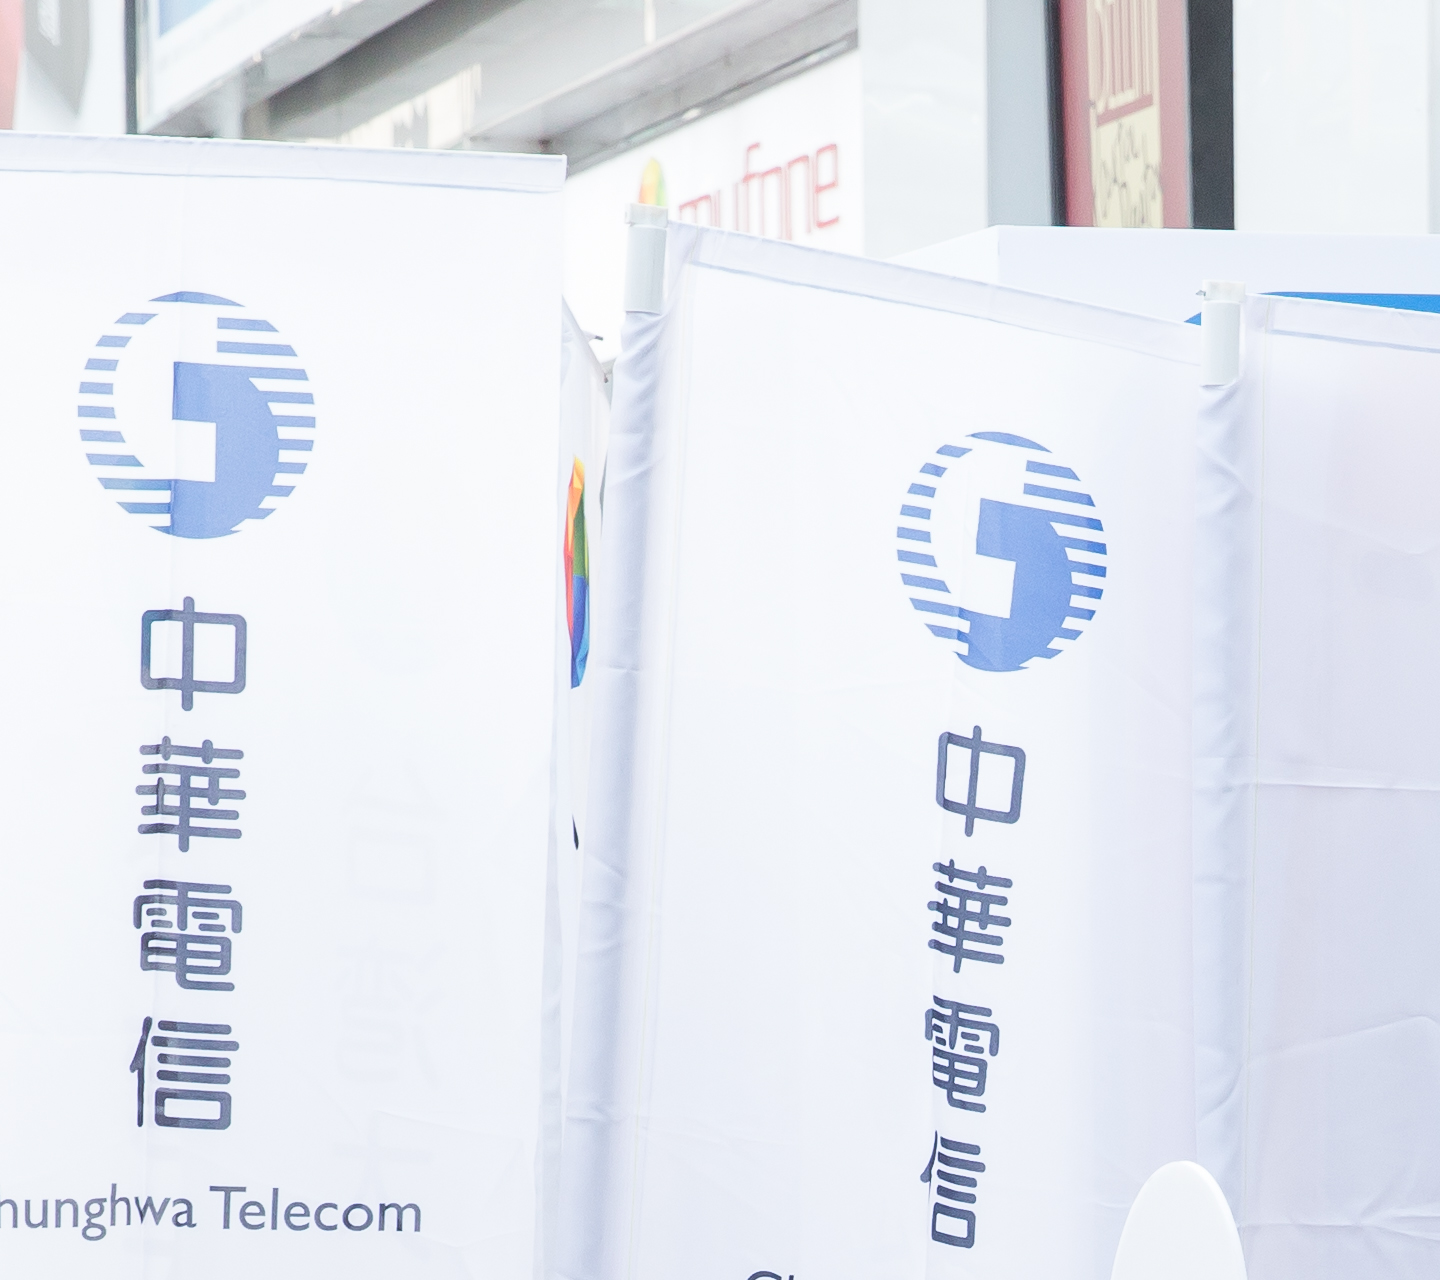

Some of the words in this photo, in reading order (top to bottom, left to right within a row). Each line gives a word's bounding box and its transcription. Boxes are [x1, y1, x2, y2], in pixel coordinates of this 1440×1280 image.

[130, 597, 247, 1130] 中華電信
[920, 725, 1026, 1248] 中華電信
[210, 1186, 421, 1232] Telecom
